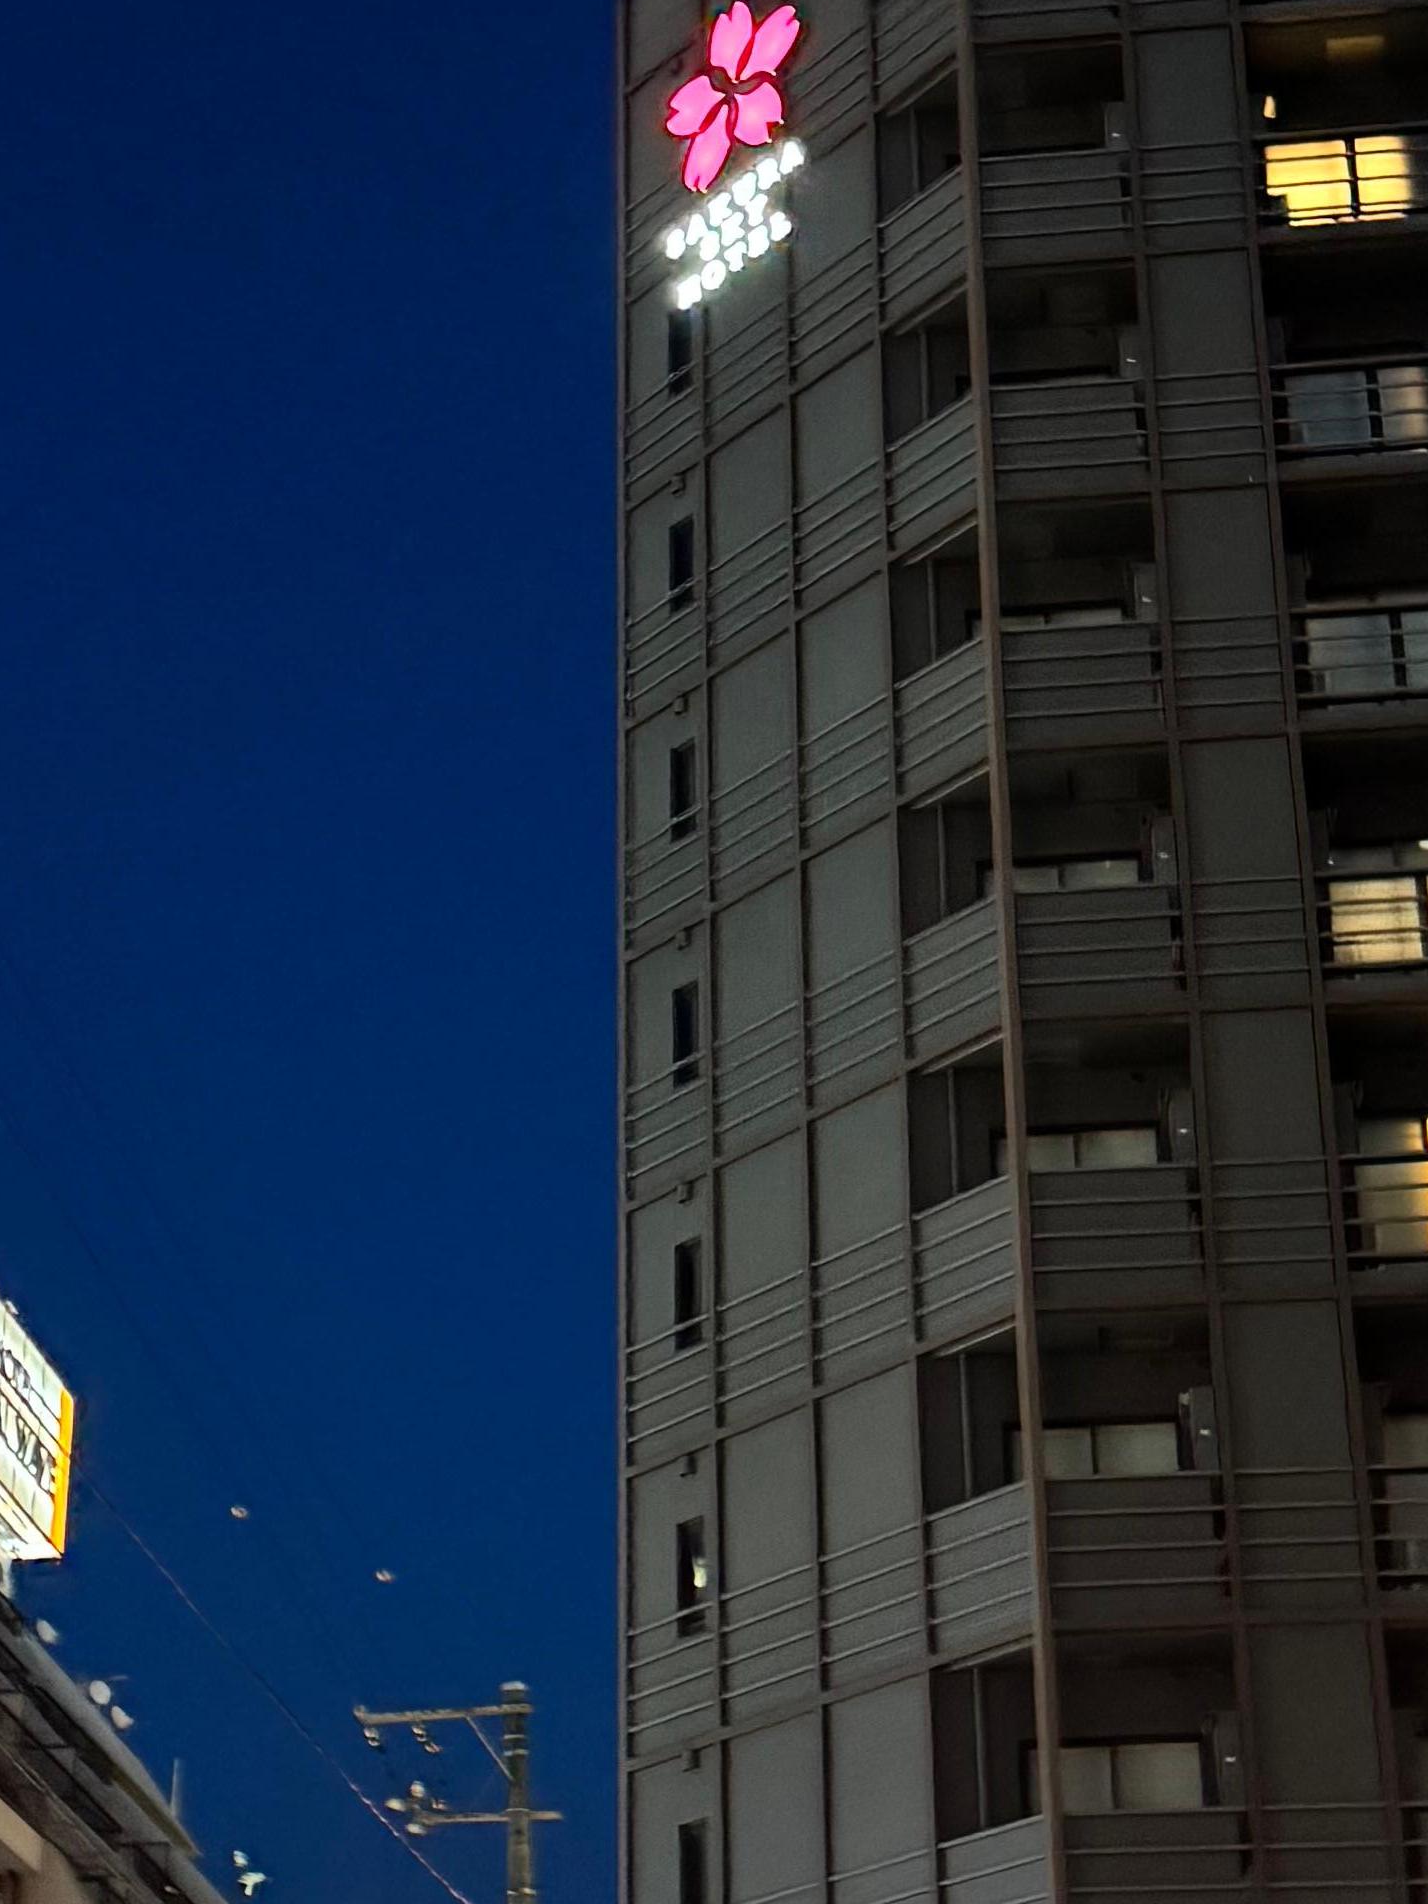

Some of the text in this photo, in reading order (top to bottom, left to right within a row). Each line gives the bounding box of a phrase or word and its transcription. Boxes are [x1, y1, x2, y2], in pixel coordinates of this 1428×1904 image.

[666, 141, 804, 260] SAKURA
[699, 192, 769, 262] SKY
[676, 211, 792, 310] HOTEL
